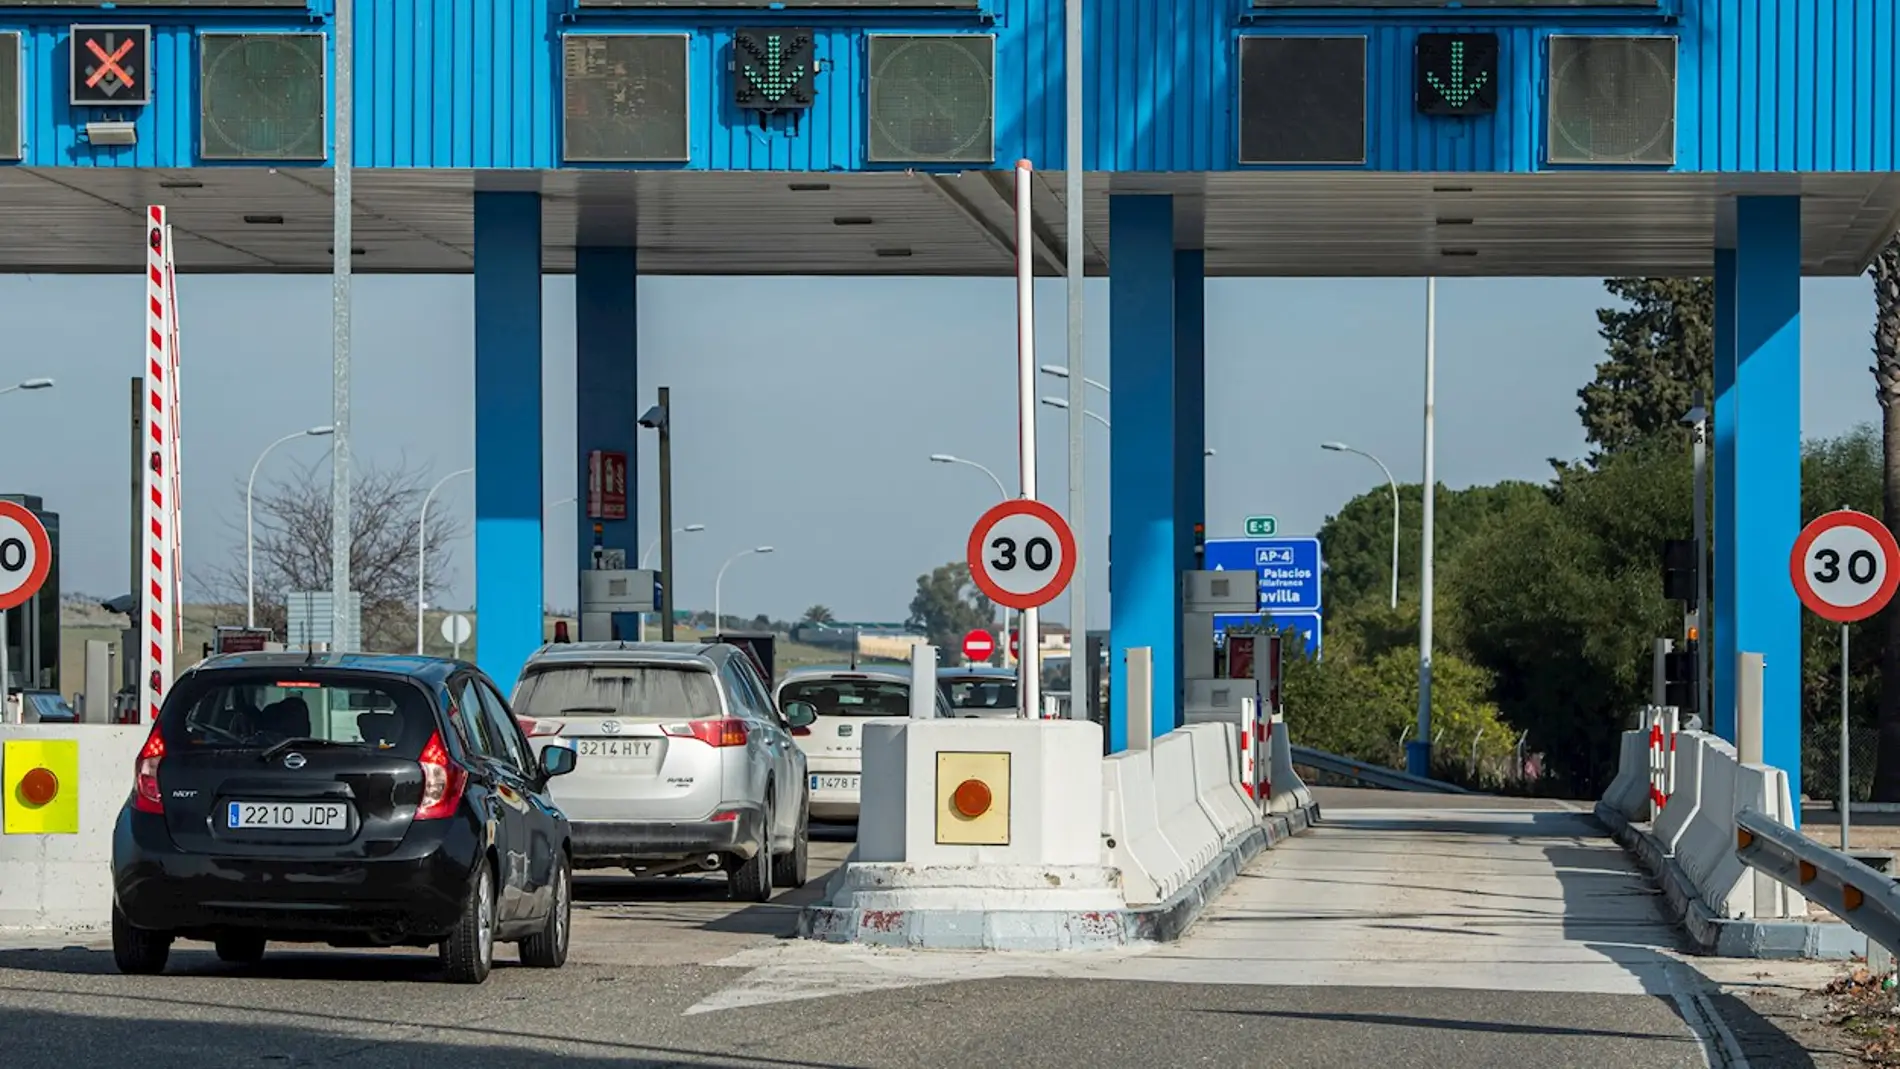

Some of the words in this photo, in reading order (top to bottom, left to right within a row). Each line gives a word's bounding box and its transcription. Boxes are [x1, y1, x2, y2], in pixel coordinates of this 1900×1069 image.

[990, 536, 1053, 571] 30
[1259, 550, 1291, 562] AP-4
[1263, 568, 1312, 579] Palacios
[1813, 548, 1877, 585] 30
[1259, 589, 1301, 603] evilla
[580, 741, 617, 755] 3214
[821, 778, 848, 789] 1478
[245, 806, 294, 824] 2210
[301, 807, 338, 825] JDP
